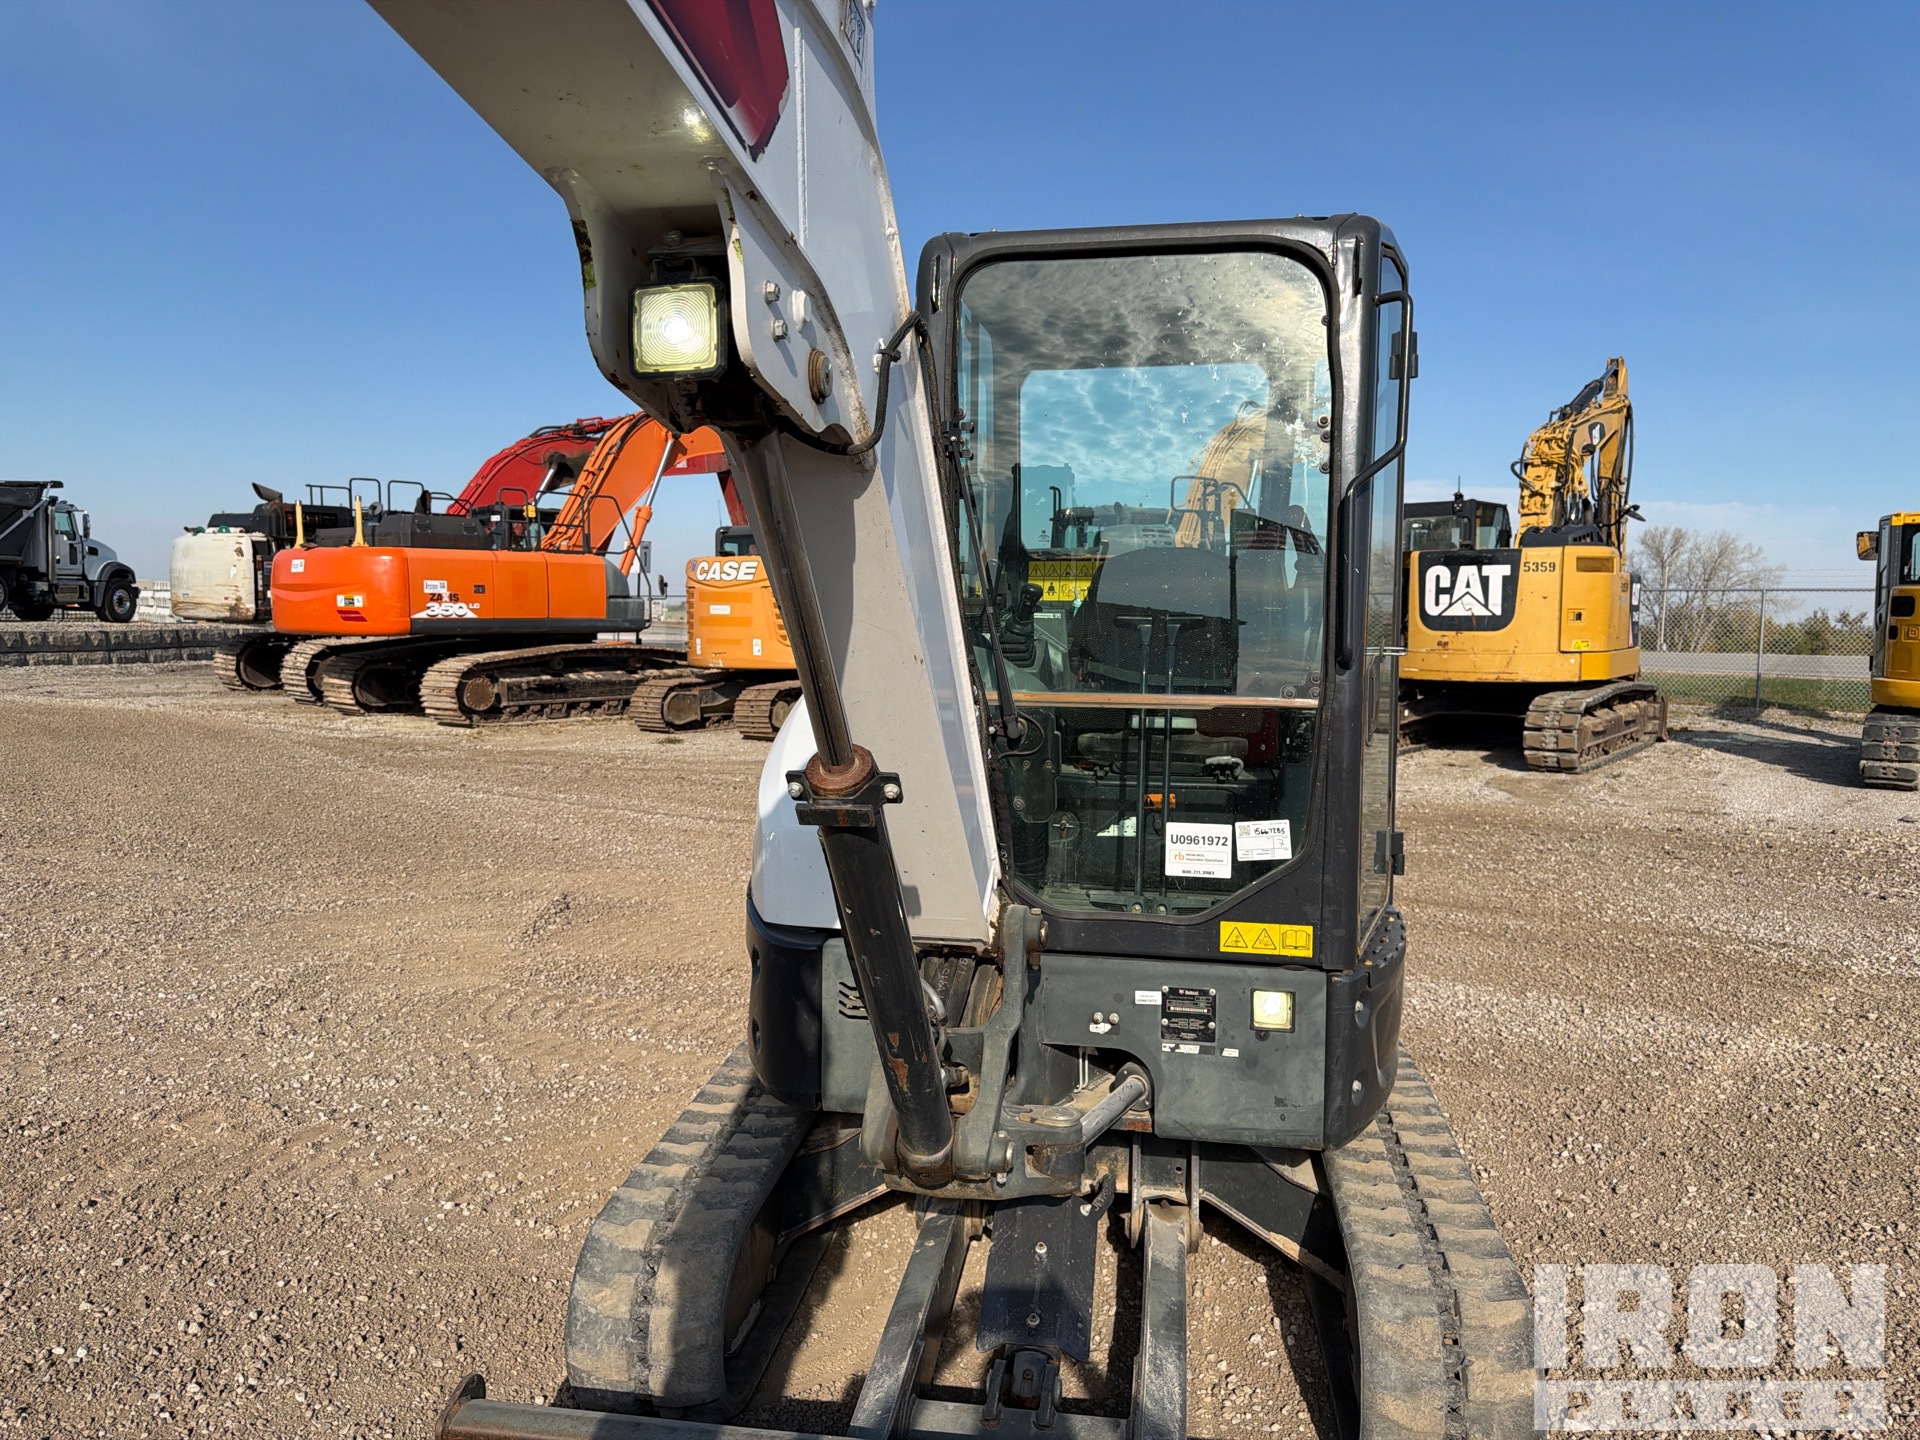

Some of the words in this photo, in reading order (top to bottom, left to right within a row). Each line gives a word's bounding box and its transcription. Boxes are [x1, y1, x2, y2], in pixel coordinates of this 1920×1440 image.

[695, 560, 760, 581] CASE
[1523, 561, 1557, 573] 5359
[1424, 564, 1512, 617] CAT
[429, 593, 460, 602] ZAXIS
[426, 602, 468, 617] 350
[1170, 834, 1229, 847] U0961972
[1174, 852, 1185, 861] rb
